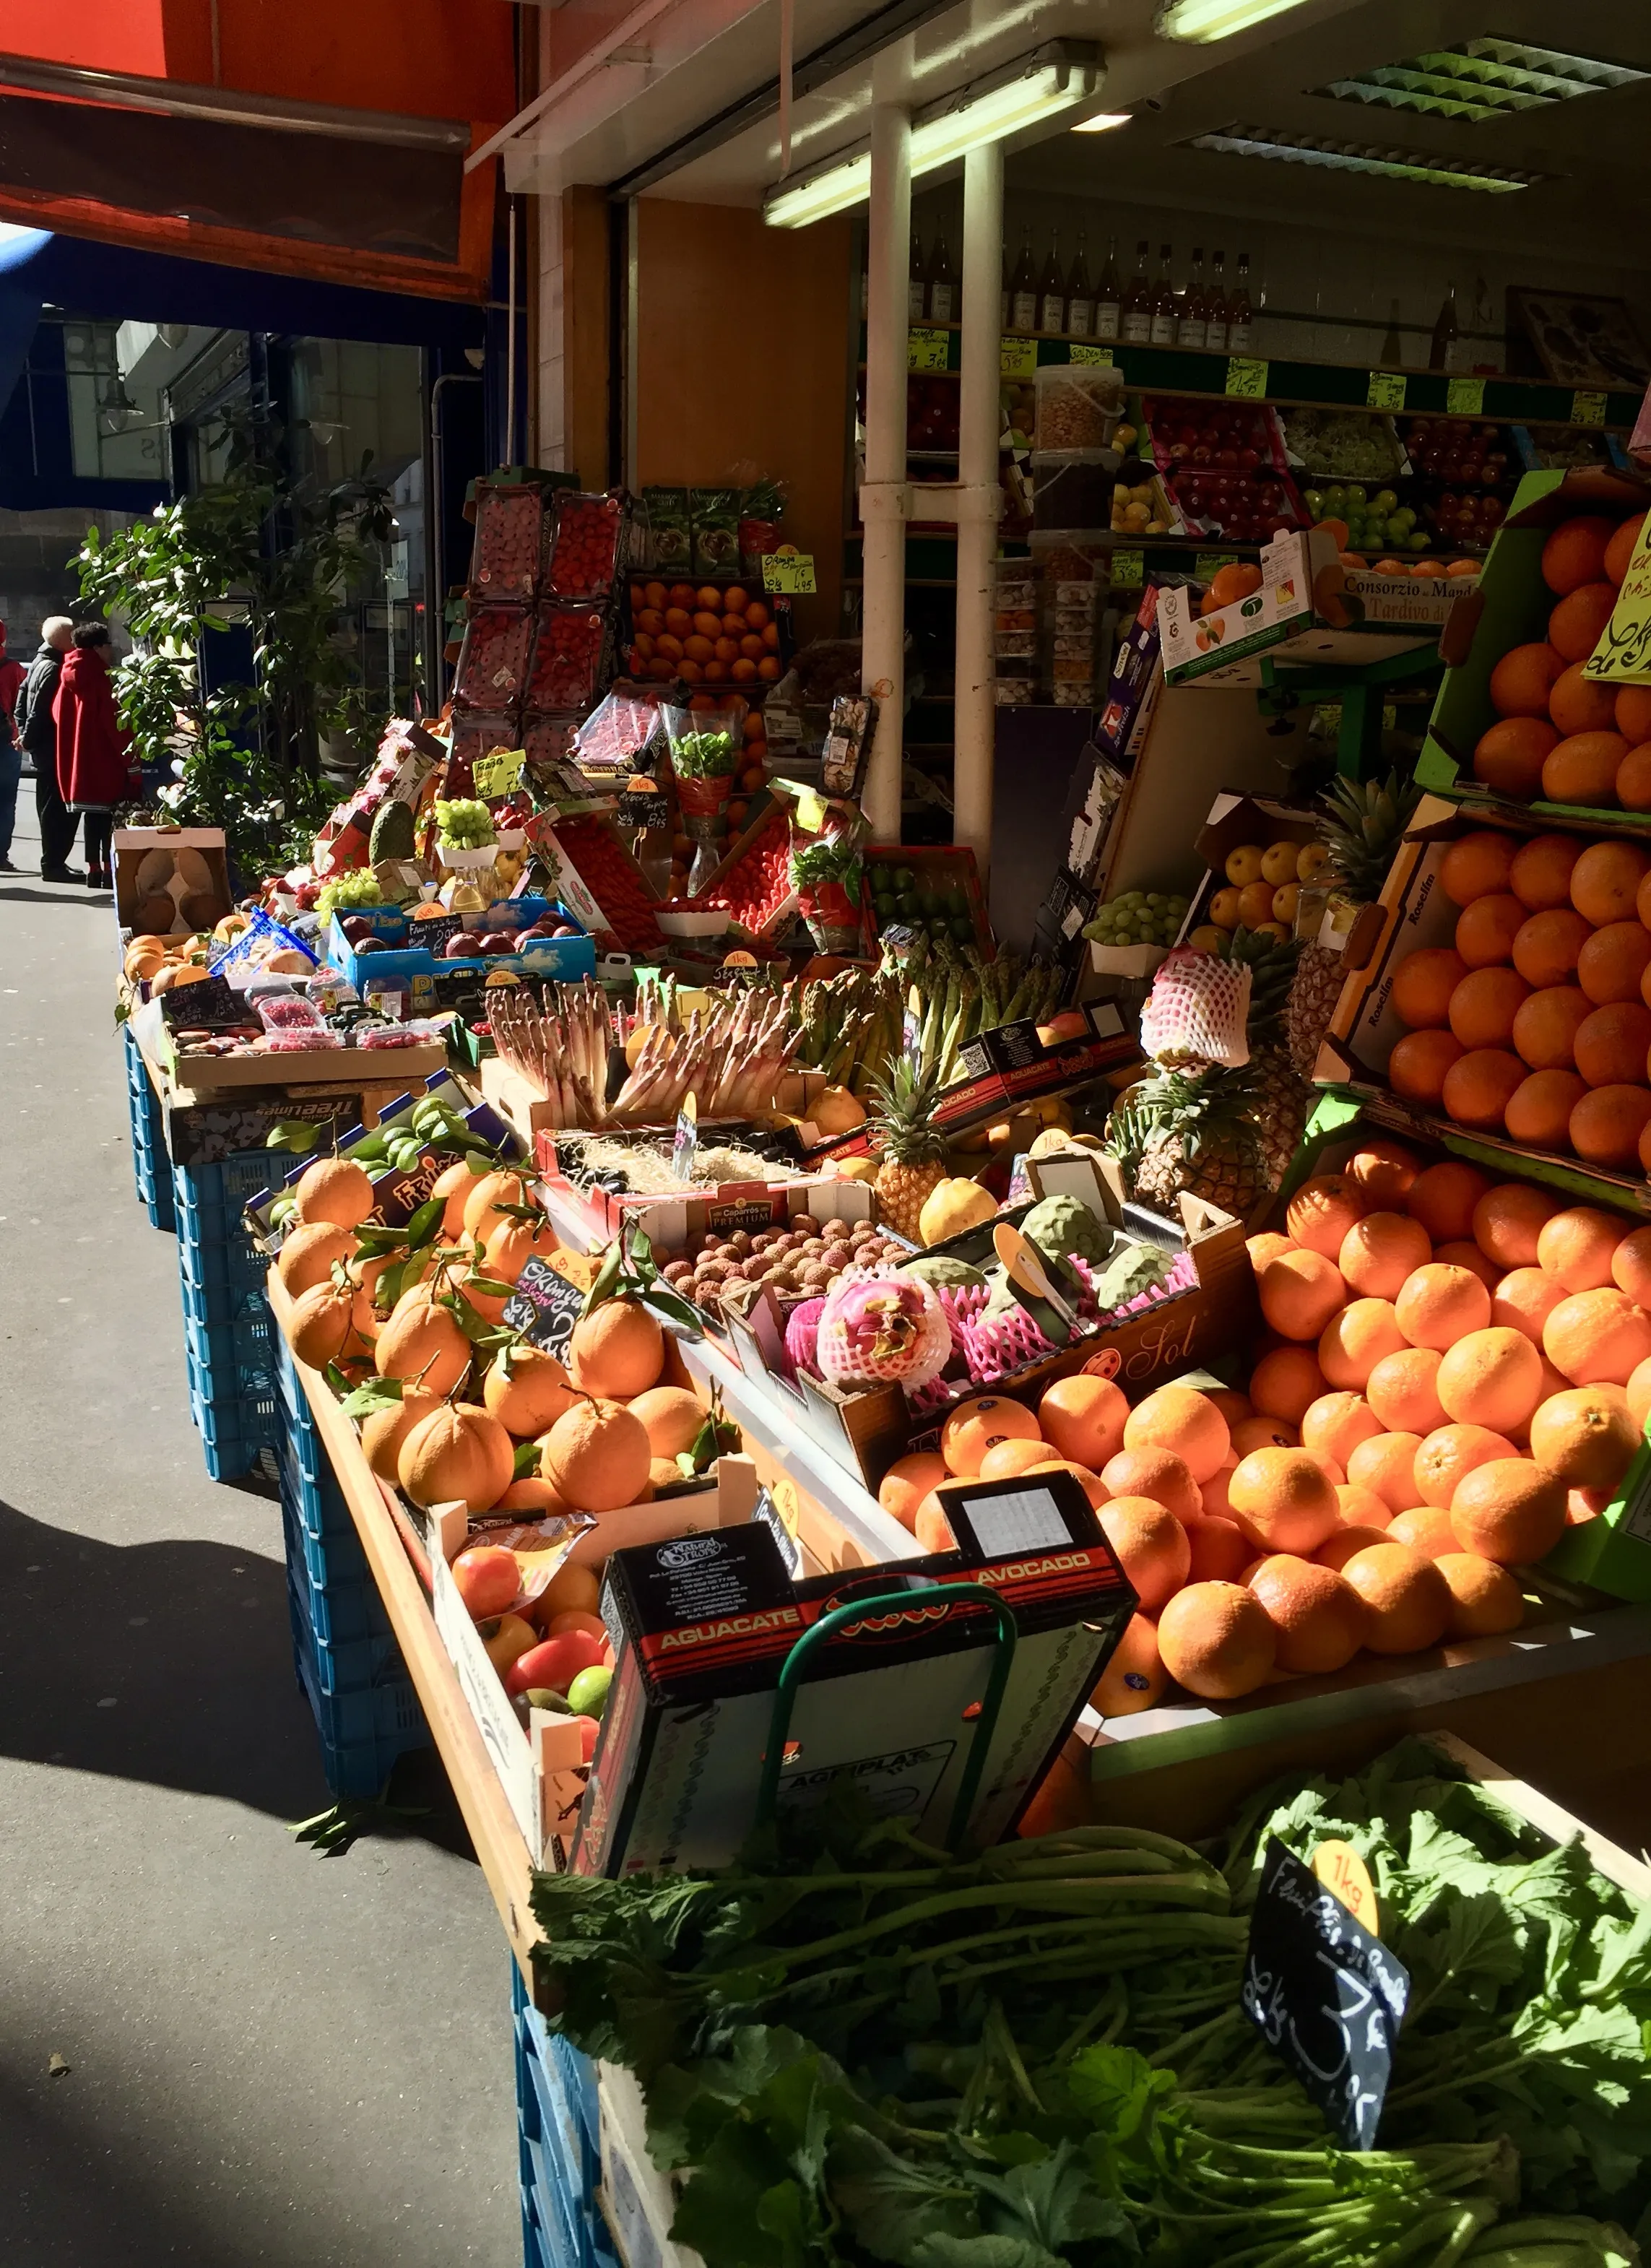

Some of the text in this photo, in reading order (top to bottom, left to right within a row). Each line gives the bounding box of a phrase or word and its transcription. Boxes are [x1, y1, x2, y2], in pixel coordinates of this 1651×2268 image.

[1344, 576, 1420, 596] Consorzio
[1370, 598, 1444, 622] Tardivo di
[636, 780, 649, 789] 1kg
[419, 908, 433, 919] 1kg
[732, 953, 748, 964] 1kg
[1010, 1061, 1052, 1081] AGUACATE
[713, 1213, 769, 1227] PREMIUM
[723, 1207, 760, 1217] Caparrós
[976, 1552, 1092, 1586] AVOCADO
[660, 1608, 800, 1650] AGUACATE
[1332, 1853, 1364, 1915] 1kg
